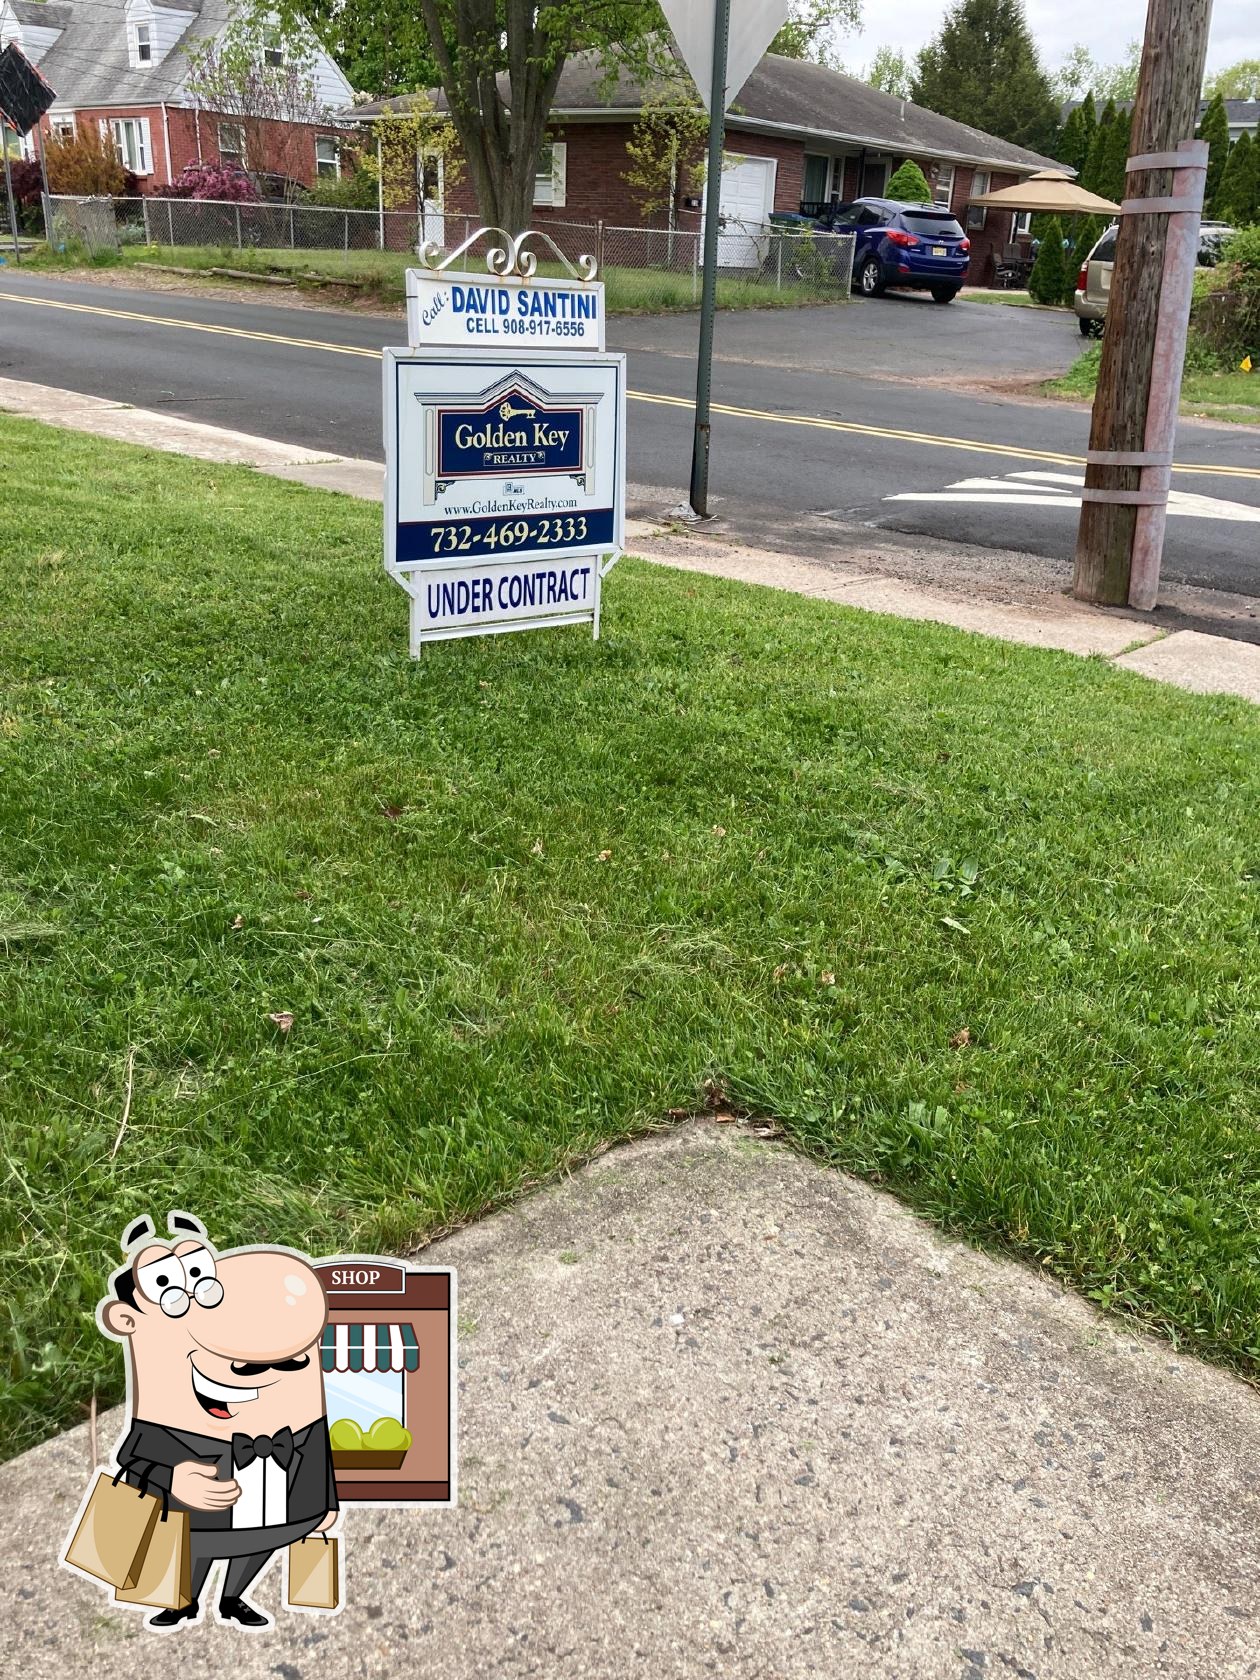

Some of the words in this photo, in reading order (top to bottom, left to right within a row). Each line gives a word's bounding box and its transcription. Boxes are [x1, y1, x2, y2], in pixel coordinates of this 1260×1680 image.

[422, 290, 450, 326] Call:
[451, 286, 511, 316] DAVID
[517, 290, 597, 320] SANTINI
[466, 317, 499, 334] CELL
[503, 318, 585, 337] 908-917-6556
[455, 423, 528, 449] Golden
[533, 423, 570, 451] Key
[493, 453, 537, 464] REALTY
[444, 497, 577, 516] www.GoldenKeyRealty.com
[430, 516, 588, 553] 732-469-2333
[427, 577, 494, 619] UNDER
[498, 567, 591, 610] CONTRACT
